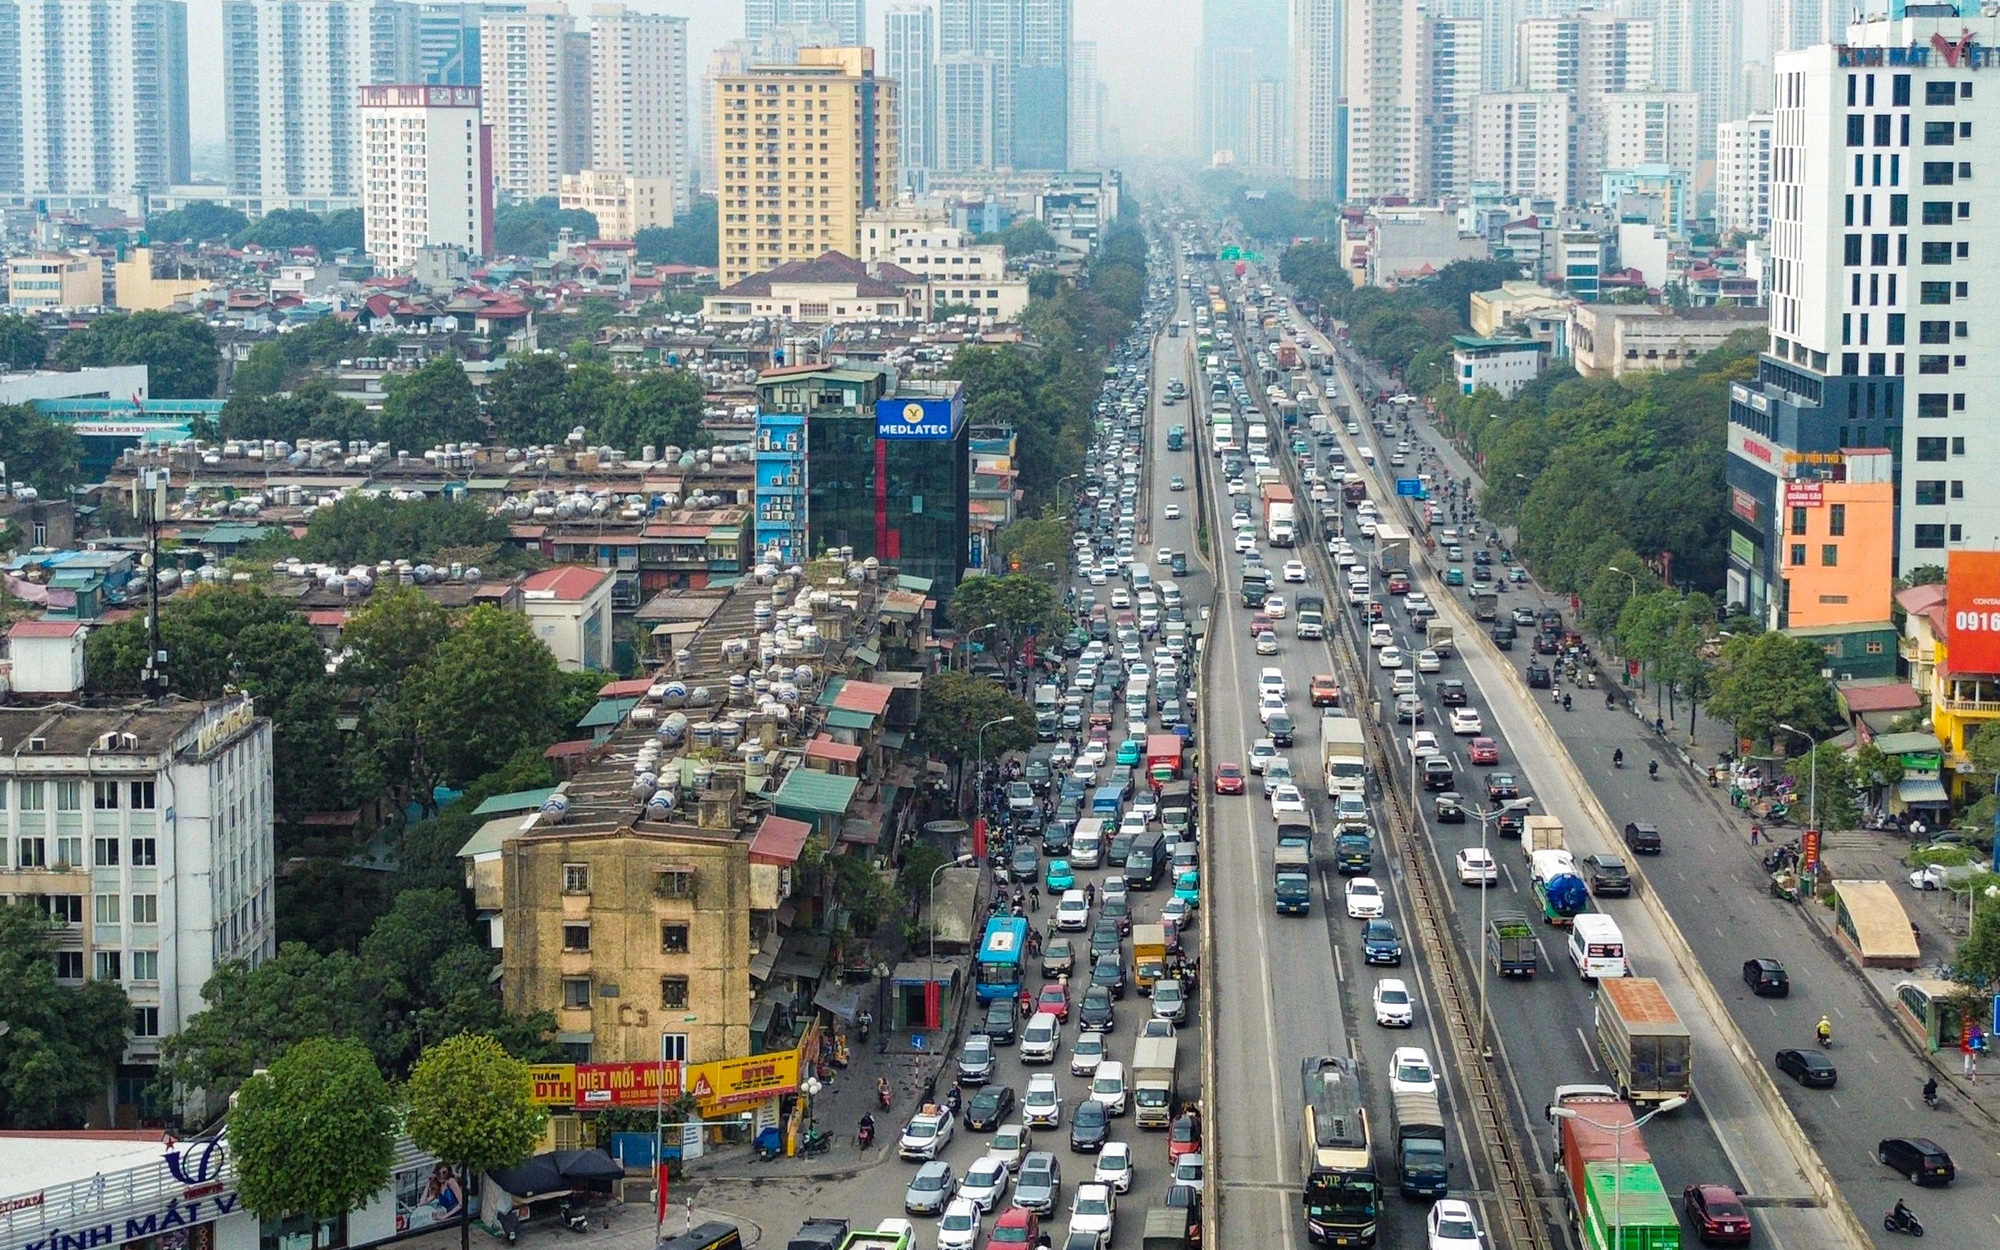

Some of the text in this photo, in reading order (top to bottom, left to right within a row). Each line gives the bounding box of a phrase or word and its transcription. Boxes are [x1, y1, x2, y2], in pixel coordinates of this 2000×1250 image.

[880, 424, 948, 435] MEDLATEC
[1956, 611, 2000, 631] 0916
[578, 1069, 605, 1092] DIỆT
[610, 1066, 634, 1088] MỐI
[1323, 1175, 1340, 1186] VIP
[126, 1197, 201, 1238] MẮT
